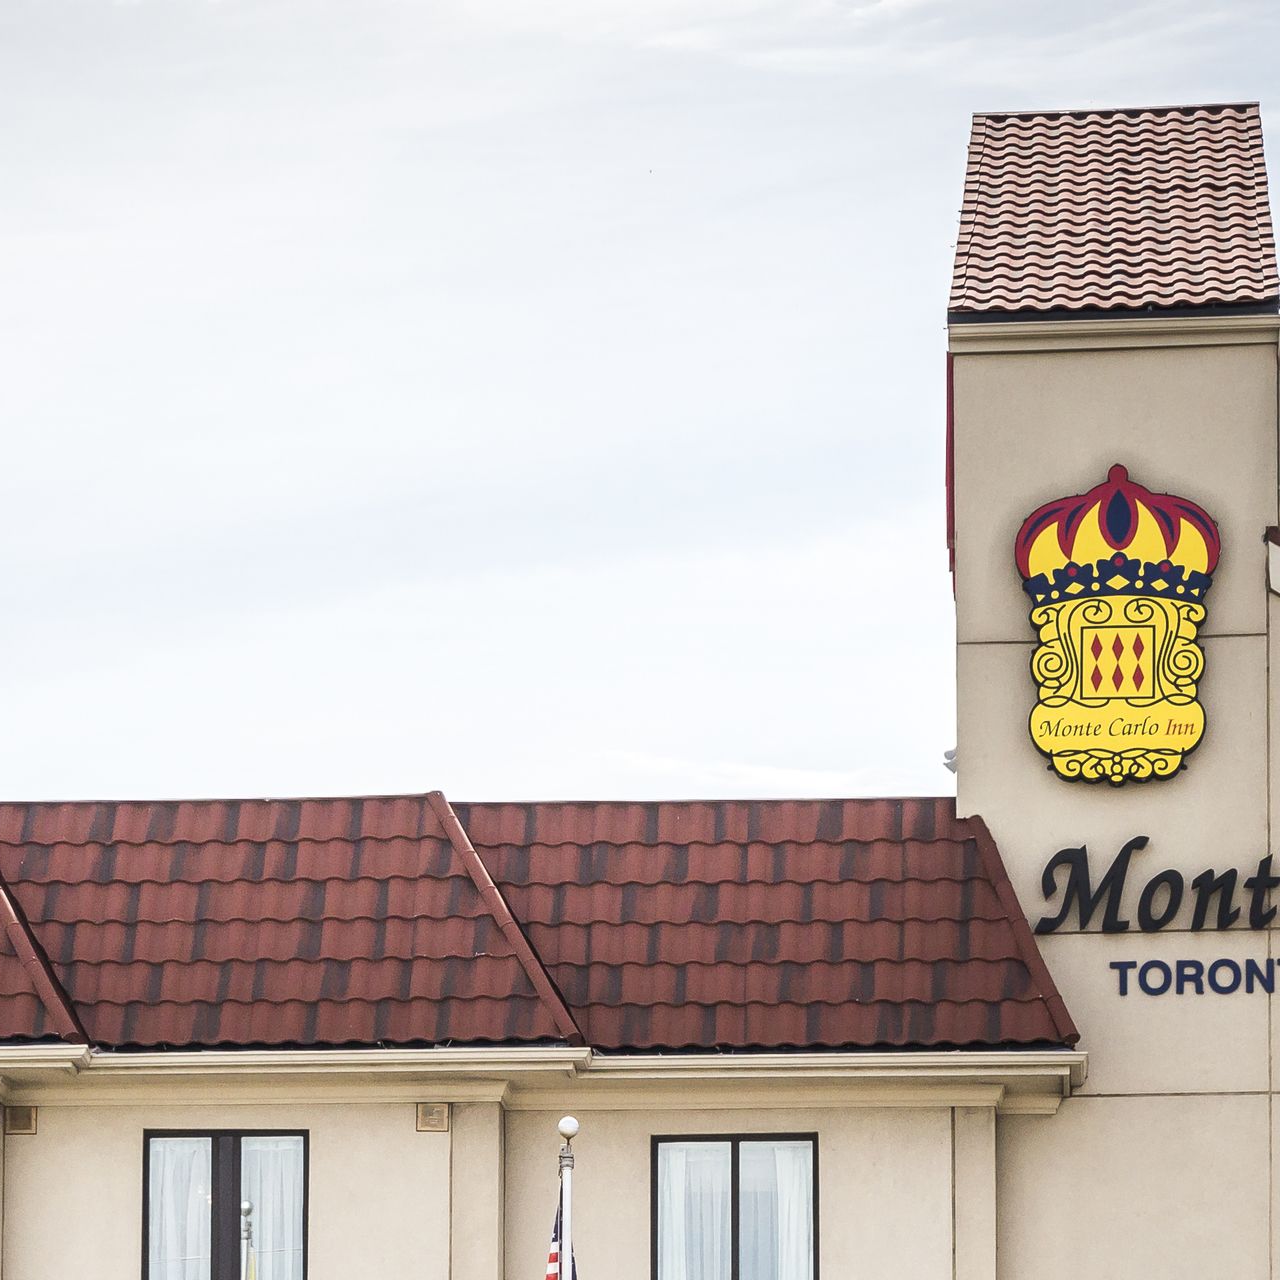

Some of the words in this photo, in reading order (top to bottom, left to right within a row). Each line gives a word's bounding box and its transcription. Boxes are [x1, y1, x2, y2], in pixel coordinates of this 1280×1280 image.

[1038, 717, 1102, 738] Monte
[1108, 715, 1159, 737] Carlo
[1164, 718, 1197, 736] Inn
